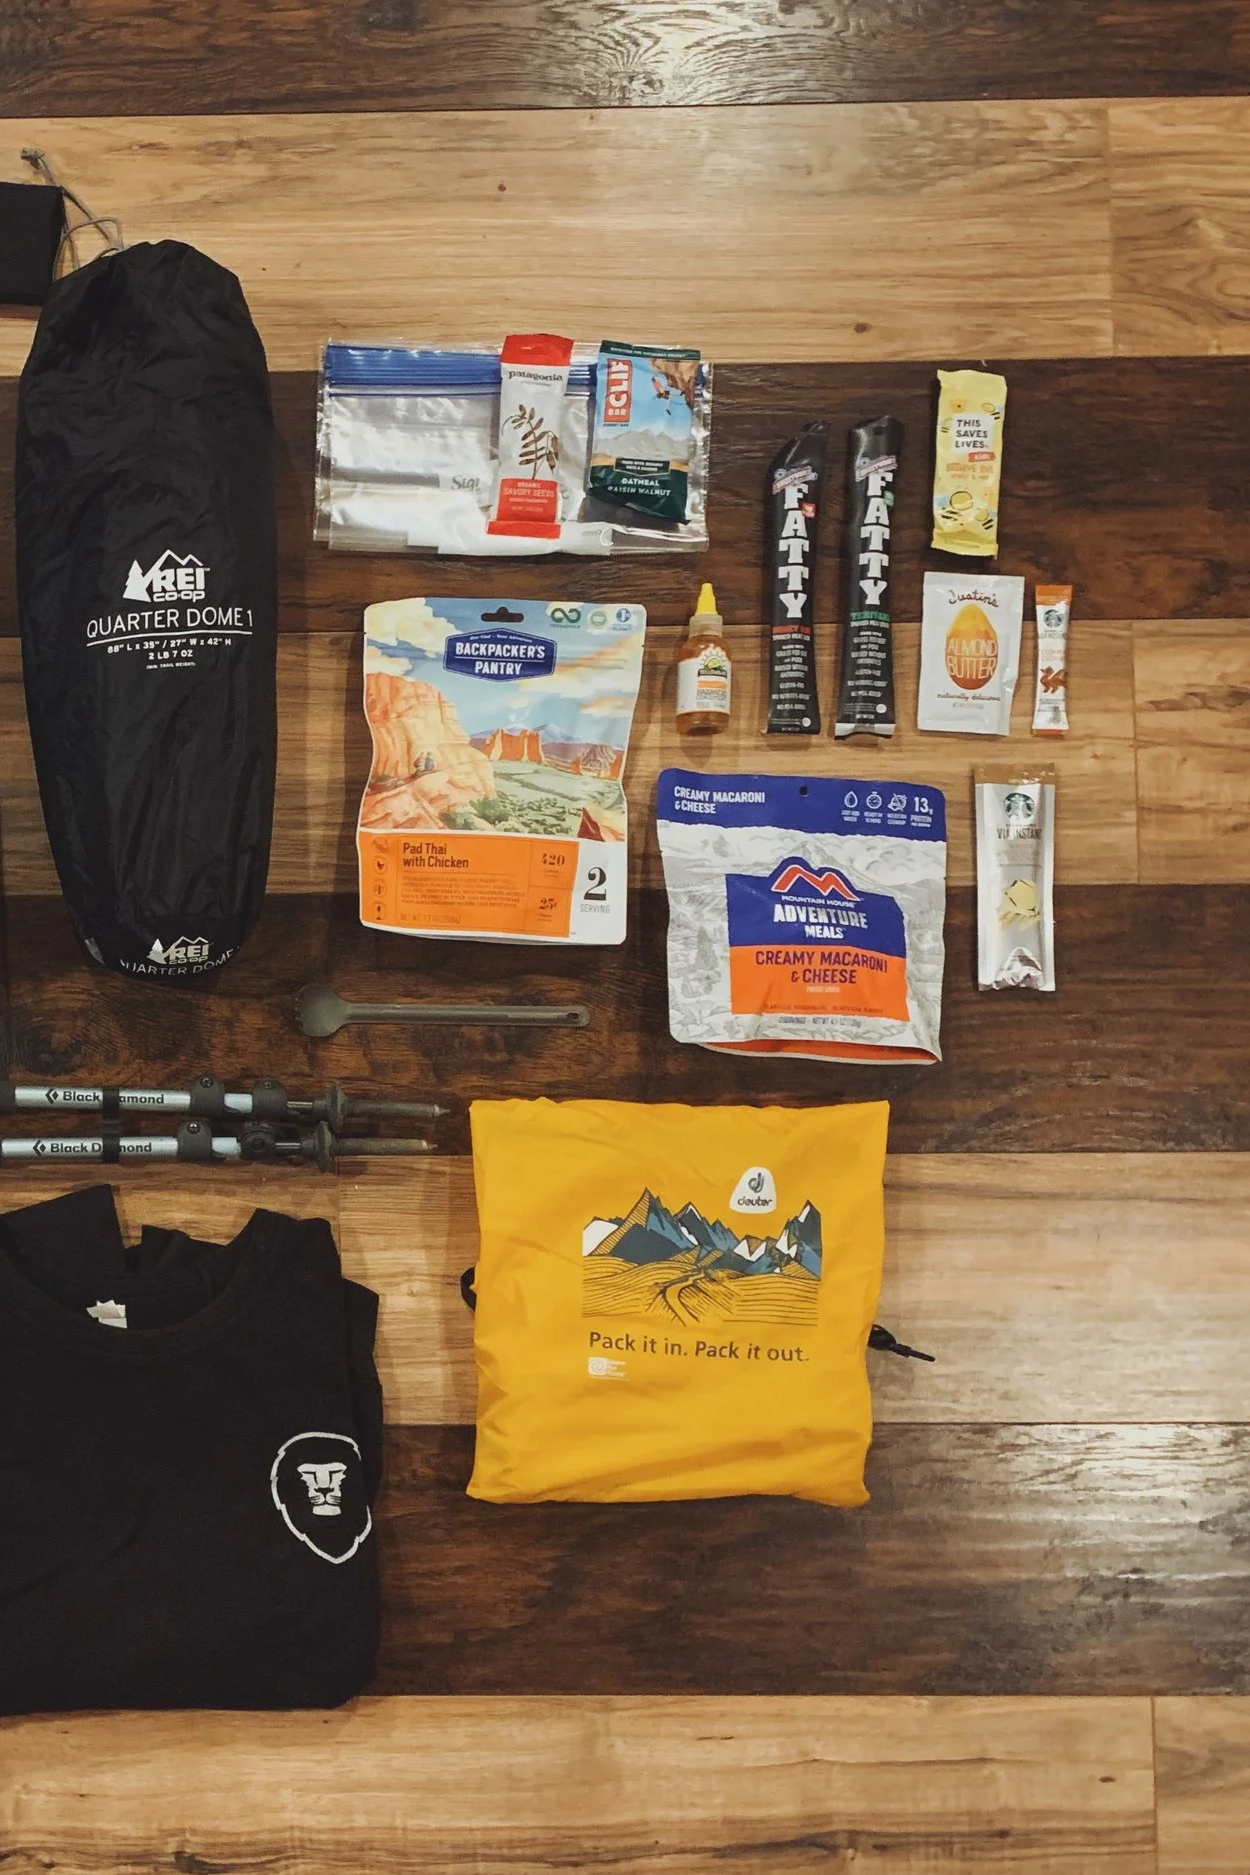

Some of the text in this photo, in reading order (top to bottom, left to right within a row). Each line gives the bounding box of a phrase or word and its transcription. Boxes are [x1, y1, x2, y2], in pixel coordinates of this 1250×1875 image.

[508, 370, 563, 381] patagonia
[609, 361, 630, 408] CLIF
[956, 419, 981, 428] THIS
[956, 429, 988, 438] SAVES
[621, 478, 660, 487] OATMEAL
[638, 488, 671, 496] WALNUT
[859, 472, 893, 605] FATTY
[778, 483, 810, 618] FATTY
[152, 567, 205, 593] REI
[948, 588, 999, 608] Justin's
[86, 607, 253, 639] QUARTER DOME 1
[126, 643, 132, 651] L
[189, 638, 197, 646] W
[225, 638, 231, 646] H
[455, 641, 545, 659] BACKPACKER'S
[947, 639, 997, 656] ALMOND
[148, 649, 193, 660] 2 LB 7 OZ
[474, 661, 523, 675] PANTRY
[947, 656, 996, 679] BUTTER
[674, 785, 766, 803] CREAMY MACARONI
[681, 801, 716, 814] CHEESE
[402, 842, 447, 855] Pad Thai
[402, 855, 469, 869] with Chicken
[583, 866, 607, 902] 2
[781, 895, 855, 908] MOUNTAIN HOUSE
[773, 904, 868, 929] ADVENTURE
[805, 925, 844, 939] MEALS
[169, 943, 210, 959] REI
[755, 951, 888, 973] CREAMY MACARONI
[791, 969, 857, 985] & CHEESE
[63, 1090, 101, 1102] Black
[51, 1142, 152, 1153] Black Dmond
[737, 1196, 772, 1207] deuter
[589, 1331, 810, 1362] Pack it in. Pack it out.
